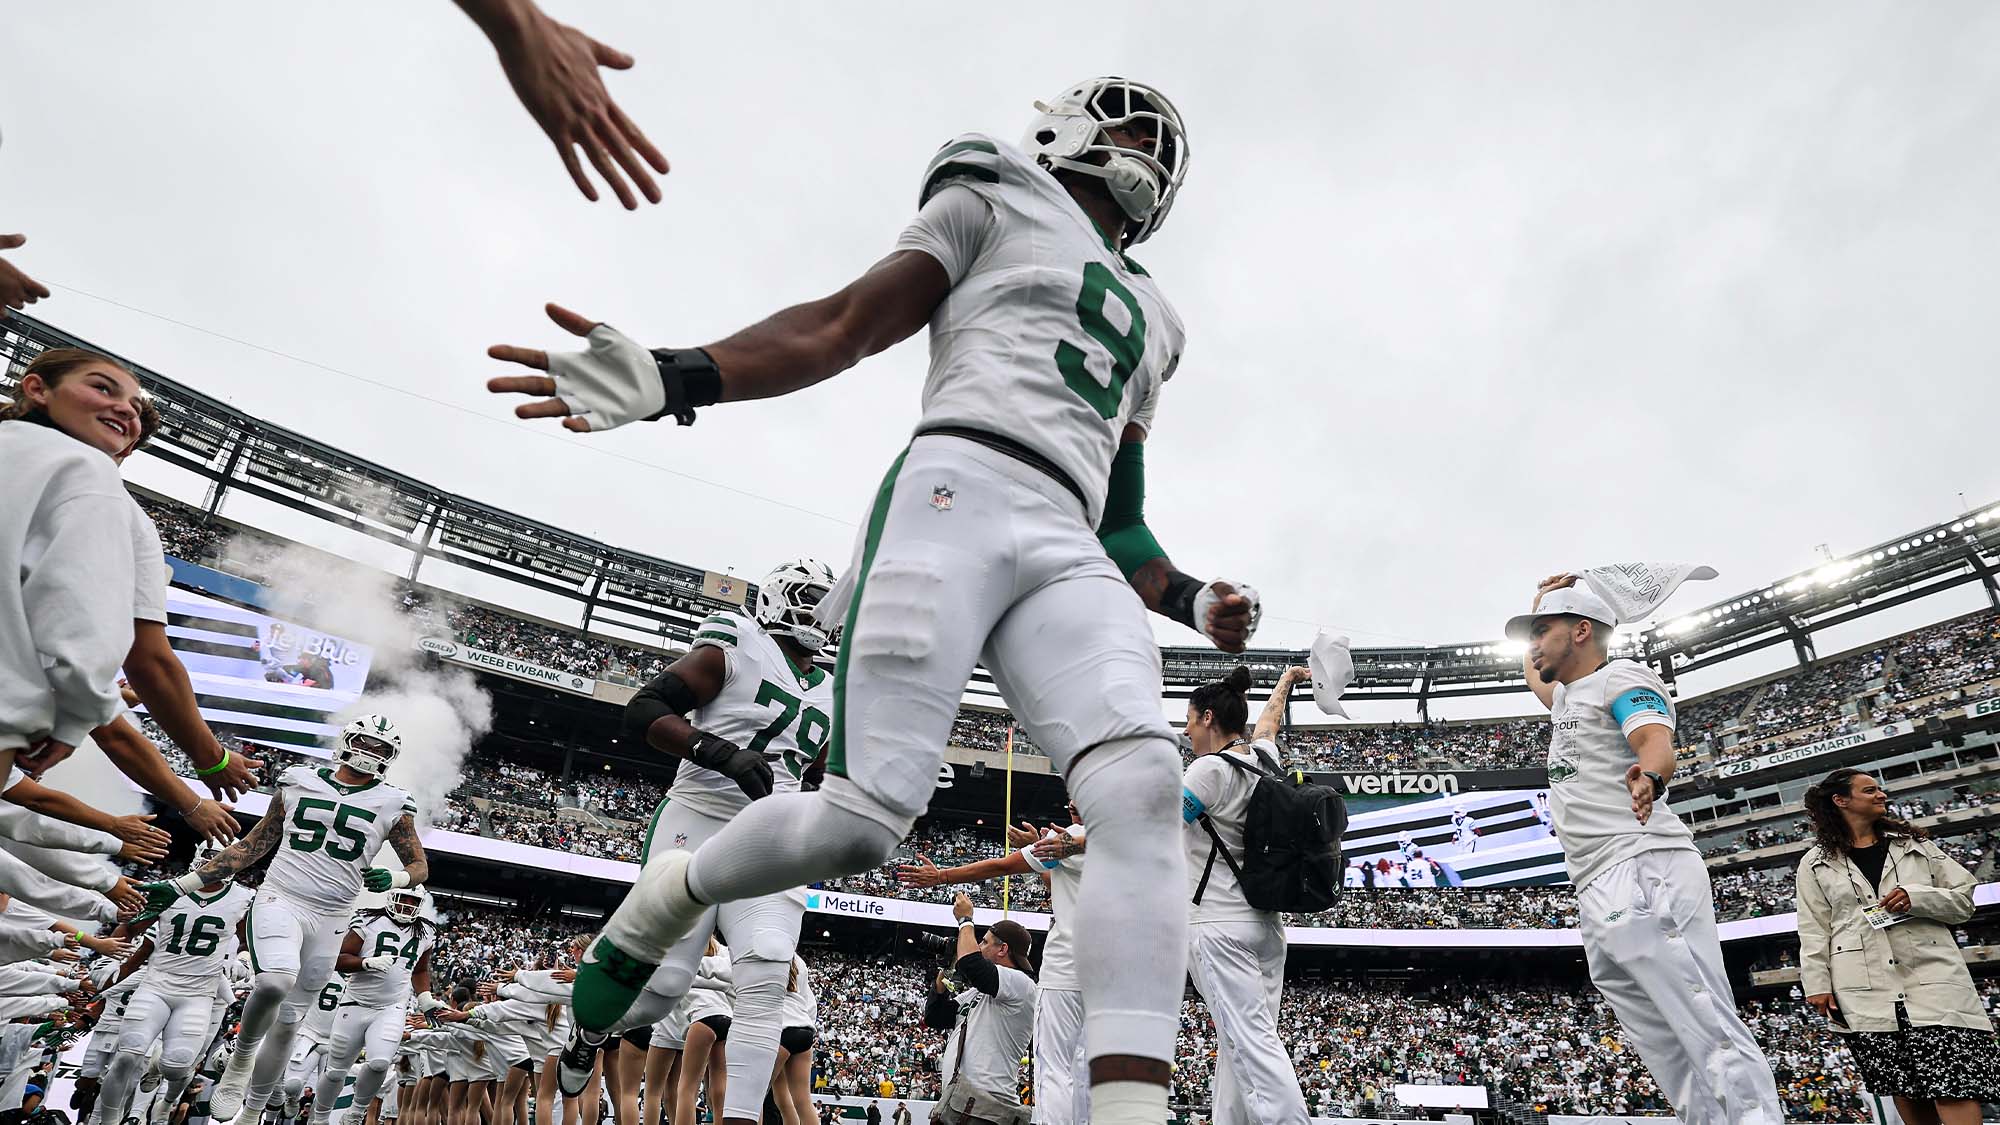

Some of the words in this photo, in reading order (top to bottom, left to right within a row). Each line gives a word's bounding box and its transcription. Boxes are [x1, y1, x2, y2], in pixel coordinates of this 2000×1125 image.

[1054, 262, 1147, 421] 9
[422, 640, 453, 654] COACH
[467, 650, 504, 668] WEEB
[506, 662, 560, 683] EWBANK
[747, 679, 831, 781] 79
[1559, 720, 1579, 730] OUT
[1731, 761, 1752, 774] 28
[1769, 747, 1812, 764] CURTIS
[1814, 733, 1866, 753] MARTIN
[1342, 769, 1459, 794] verizon
[289, 797, 377, 862] 55
[825, 896, 884, 915] MetLife
[166, 913, 225, 956] 16
[373, 931, 420, 970] 64
[319, 982, 343, 1011] 6
